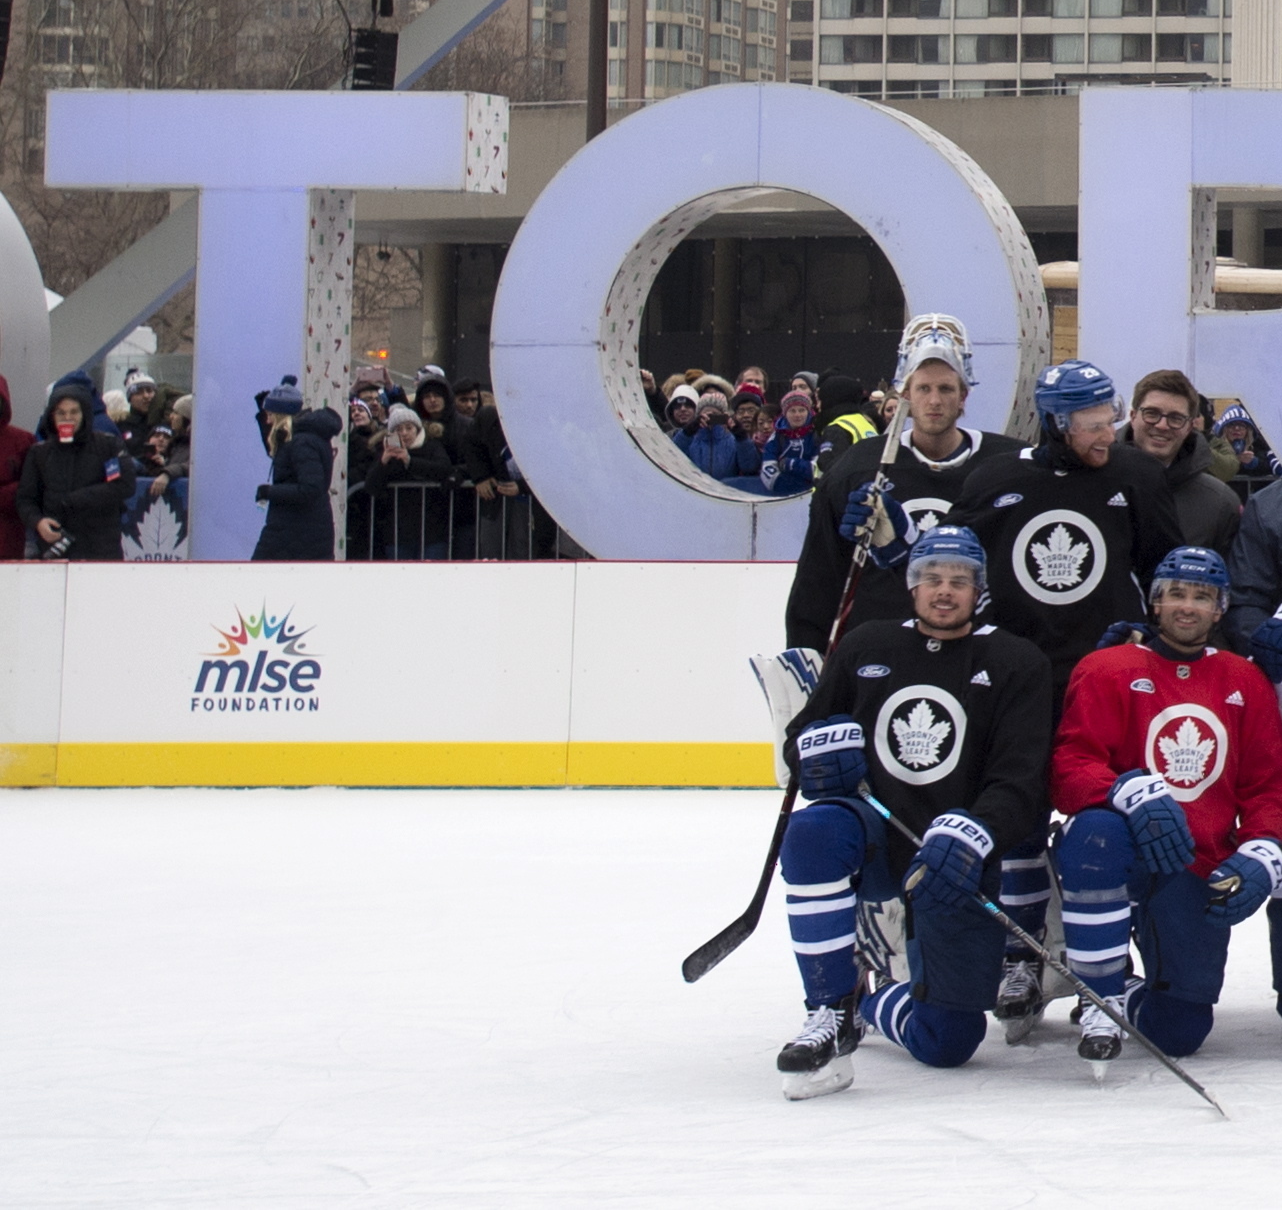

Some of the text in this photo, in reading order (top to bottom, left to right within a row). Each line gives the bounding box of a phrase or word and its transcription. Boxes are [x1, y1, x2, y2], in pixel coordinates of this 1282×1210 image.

[938, 527, 958, 535] 34
[1042, 554, 1078, 564] TORONTO
[1180, 564, 1206, 573] CCM
[194, 650, 322, 694] mlse
[191, 697, 320, 712] FOUNDATION
[800, 727, 858, 748] BAUE
[901, 732, 938, 743] TORONTO
[1170, 749, 1204, 761] TORONTO
[1174, 765, 1199, 773] LEAFS
[1124, 781, 1165, 809] CC
